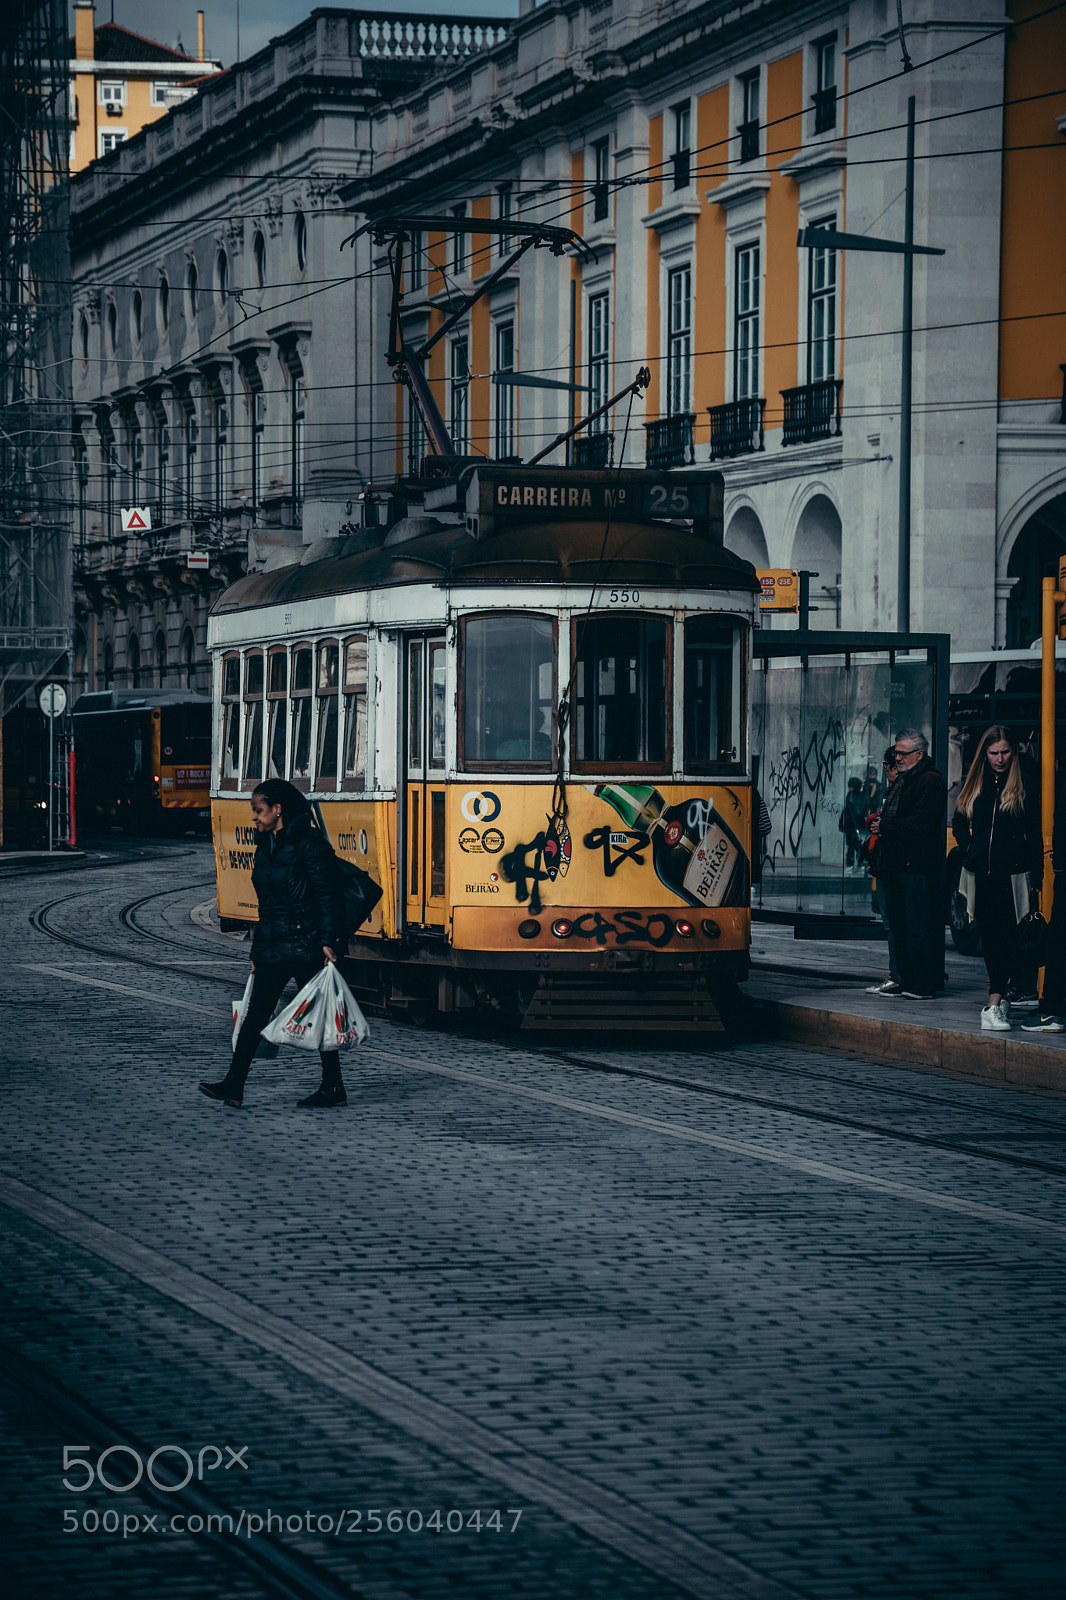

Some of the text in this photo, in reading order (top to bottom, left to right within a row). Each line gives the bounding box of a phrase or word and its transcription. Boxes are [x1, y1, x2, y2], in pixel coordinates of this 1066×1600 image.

[497, 485, 592, 507] CARREIRA
[650, 485, 689, 513] 25
[609, 589, 640, 603] 550
[611, 834, 627, 843] KIRA
[697, 839, 727, 897] BEIRÃO
